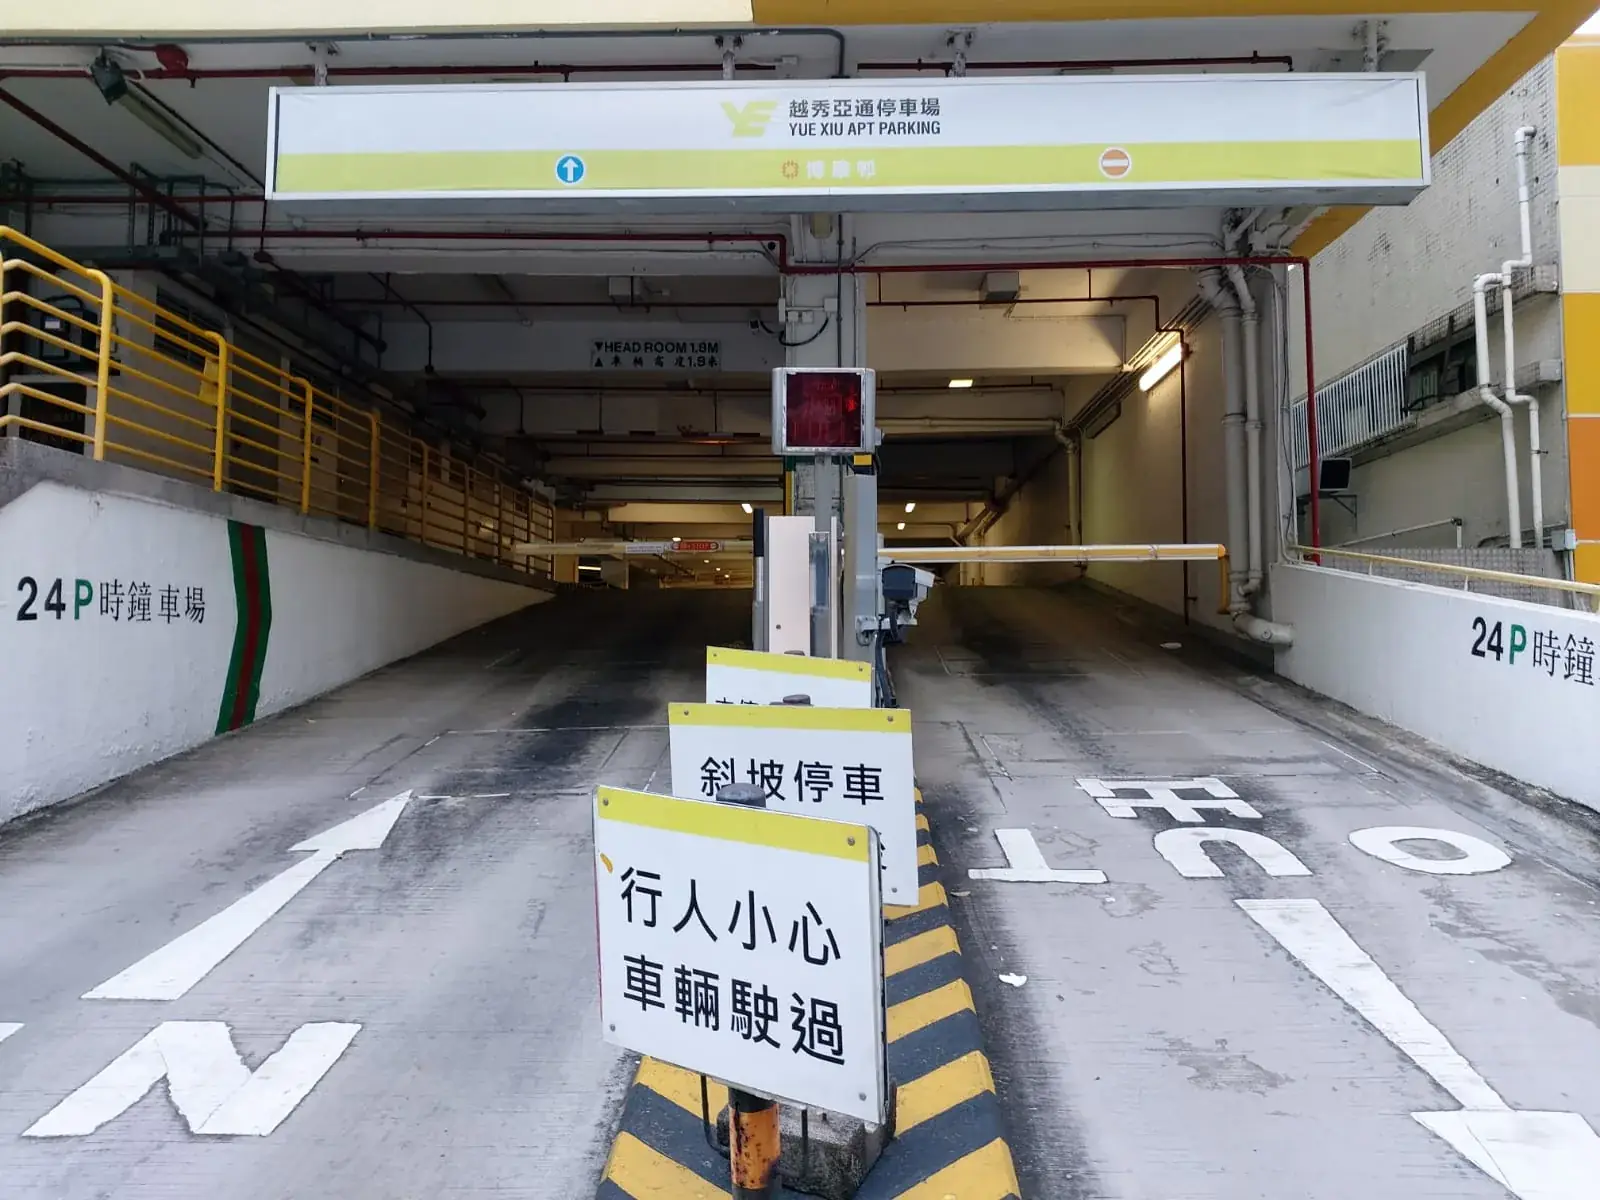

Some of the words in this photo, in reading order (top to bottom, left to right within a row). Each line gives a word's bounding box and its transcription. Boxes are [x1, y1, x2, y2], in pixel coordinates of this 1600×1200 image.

[789, 98, 940, 118] 越秀亞通停車場
[789, 123, 816, 136] YUE
[820, 122, 844, 136] XIU
[847, 122, 875, 135] APT
[879, 121, 941, 135] PARKING
[604, 341, 641, 353] HEAD
[644, 341, 686, 353] ROOM
[700, 756, 884, 805] 斜坡停車
[1075, 777, 1263, 822] 出
[968, 826, 1514, 884] OUT
[620, 866, 841, 966] 行人小心
[623, 954, 845, 1066] 車輛駛過
[0, 1020, 363, 1137] N
